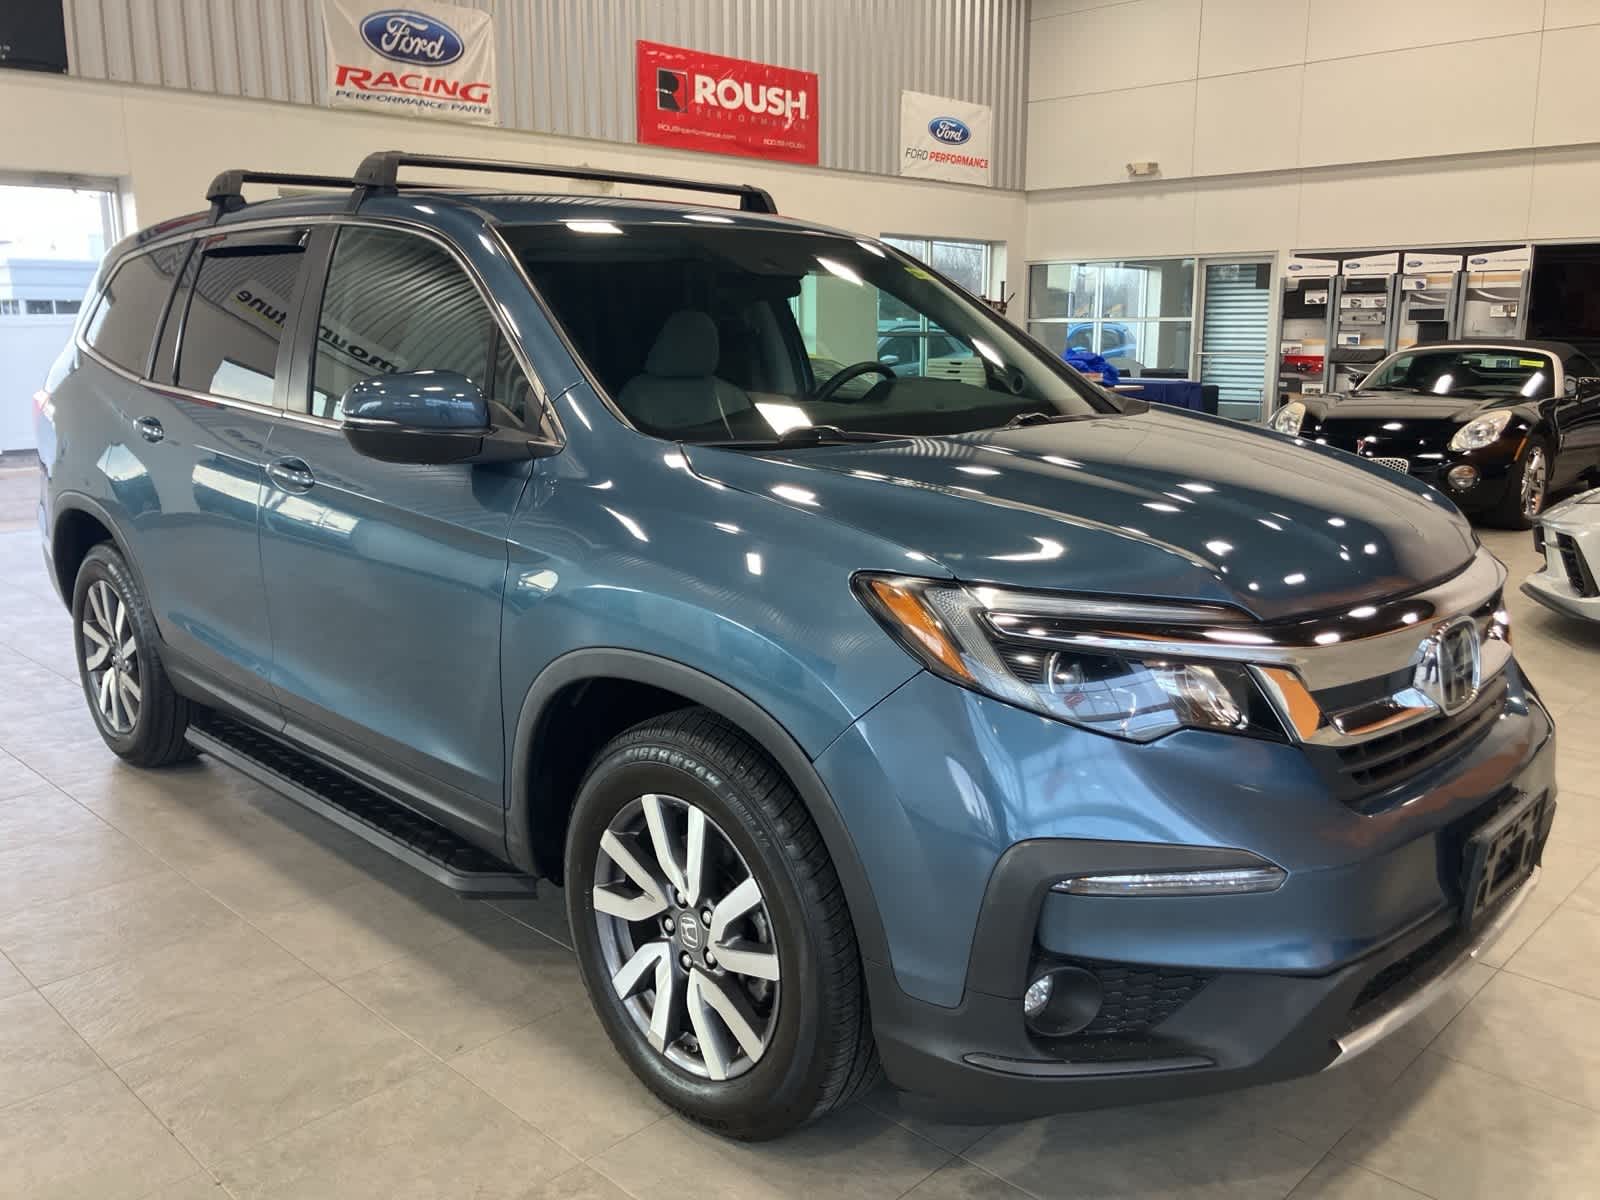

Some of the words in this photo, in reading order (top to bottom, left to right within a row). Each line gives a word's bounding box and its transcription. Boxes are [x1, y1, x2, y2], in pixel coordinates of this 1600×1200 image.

[381, 17, 444, 59] Ford
[336, 64, 491, 104] RACING
[694, 74, 808, 122] ROUSH
[335, 89, 448, 111] PERFORMANCE
[451, 104, 492, 115] PARTS
[936, 121, 962, 141] Ford
[905, 147, 928, 161] FORD
[929, 151, 989, 169] PERFORMANCE
